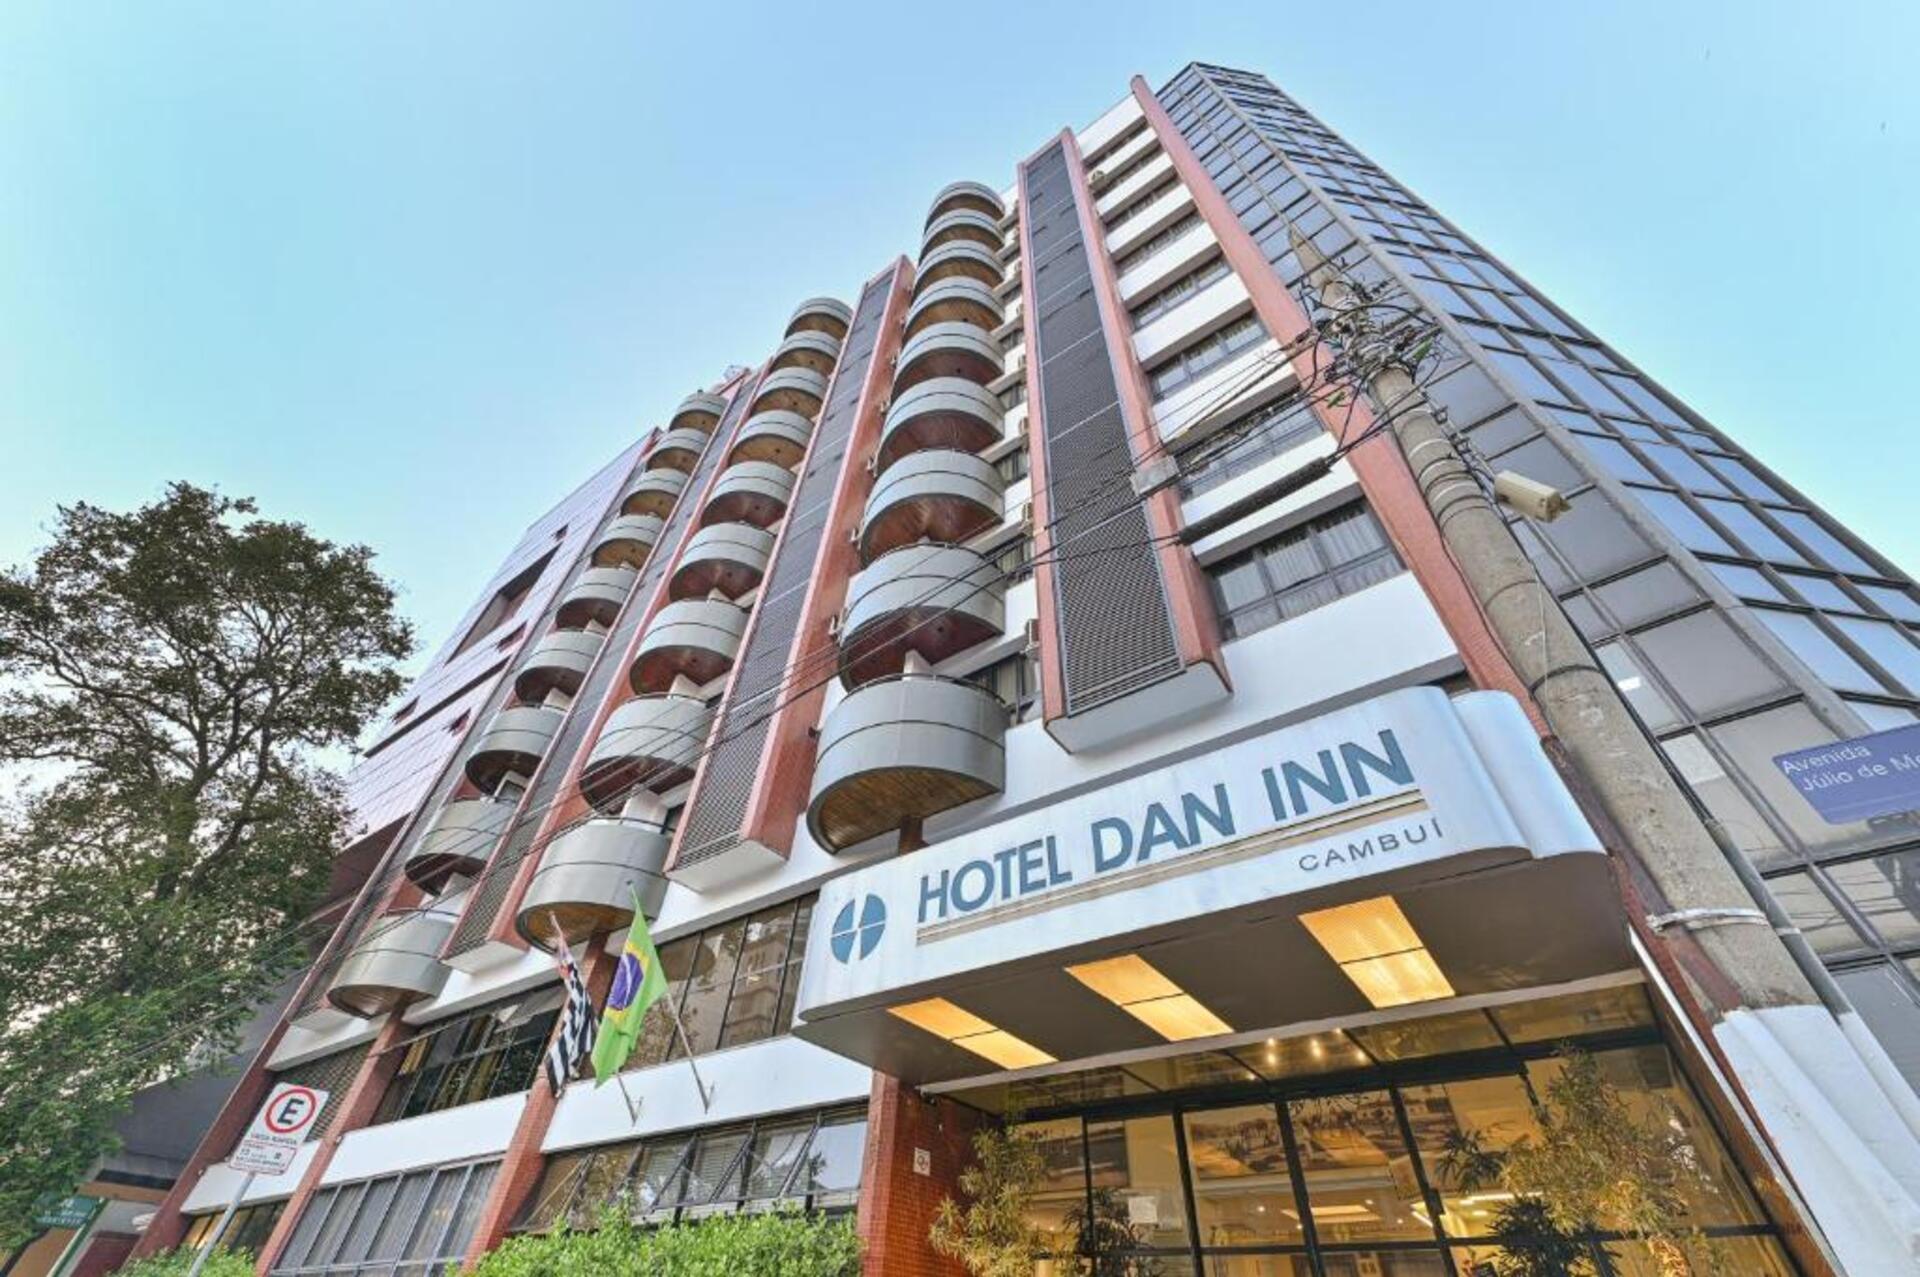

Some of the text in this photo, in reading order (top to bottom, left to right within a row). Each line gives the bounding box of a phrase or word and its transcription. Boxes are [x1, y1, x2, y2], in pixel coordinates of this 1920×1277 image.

[1782, 745, 1871, 774] Avenida
[1803, 770, 1853, 791] Júlio
[1857, 763, 1888, 778] de
[918, 729, 1414, 923] HOTEL DAN INN
[277, 1098, 304, 1124] E
